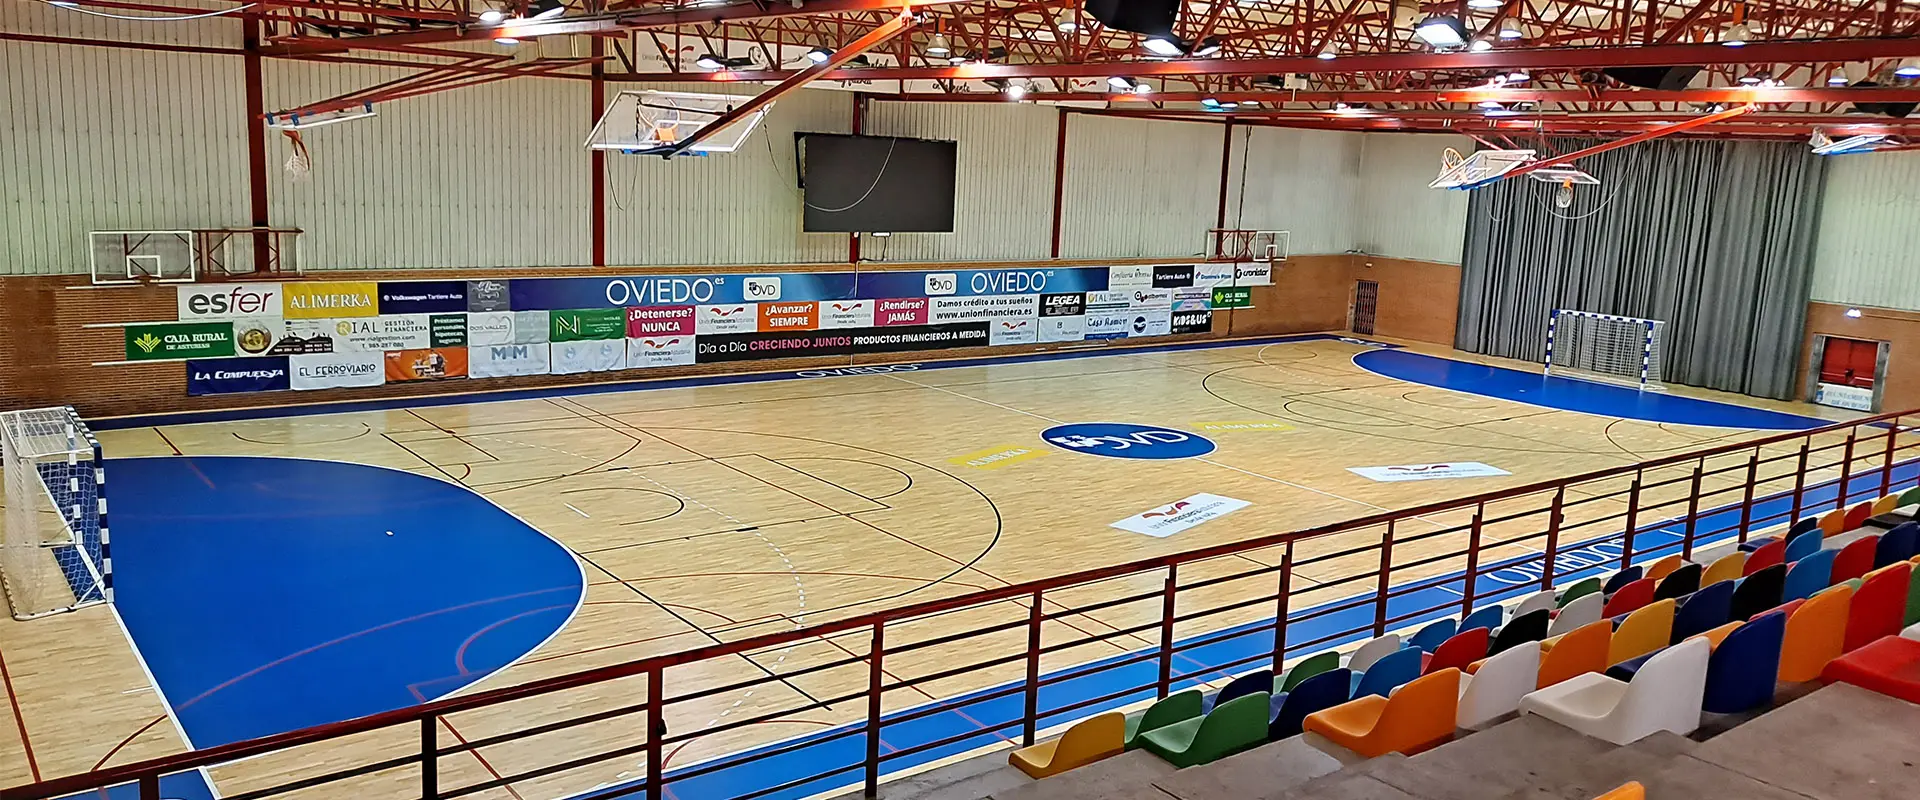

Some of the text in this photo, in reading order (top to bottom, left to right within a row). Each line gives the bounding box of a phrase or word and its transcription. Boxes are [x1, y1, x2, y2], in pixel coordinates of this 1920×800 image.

[188, 286, 273, 315] esfer
[290, 292, 372, 309] ALIMERKA
[879, 300, 925, 313] ¿Rendirse?
[937, 300, 962, 308] Damos
[963, 299, 988, 307] crédito
[996, 298, 1007, 306] tus
[1008, 297, 1033, 305] sueños
[1045, 295, 1080, 306] LEGEA
[629, 308, 693, 321] ¿Detenerse?
[765, 303, 814, 317] ¿Avanzar?
[936, 308, 1033, 320] www.unionfinanciera.es
[769, 317, 809, 327] SIEMPRE
[887, 312, 915, 325] JAMÁS
[641, 321, 681, 333] NUNCA
[164, 333, 228, 343] CAJA RURAL
[700, 342, 717, 354] Día
[730, 341, 747, 352] Día
[750, 338, 810, 350] CRECIENDO
[813, 336, 851, 347] JUNTOS
[854, 335, 901, 345] PRODUCTOS
[902, 332, 950, 343] FINANCIEROS
[959, 330, 987, 339] MEDIDA
[195, 372, 211, 380] LA
[300, 364, 376, 376] EL FERROVIARIO
